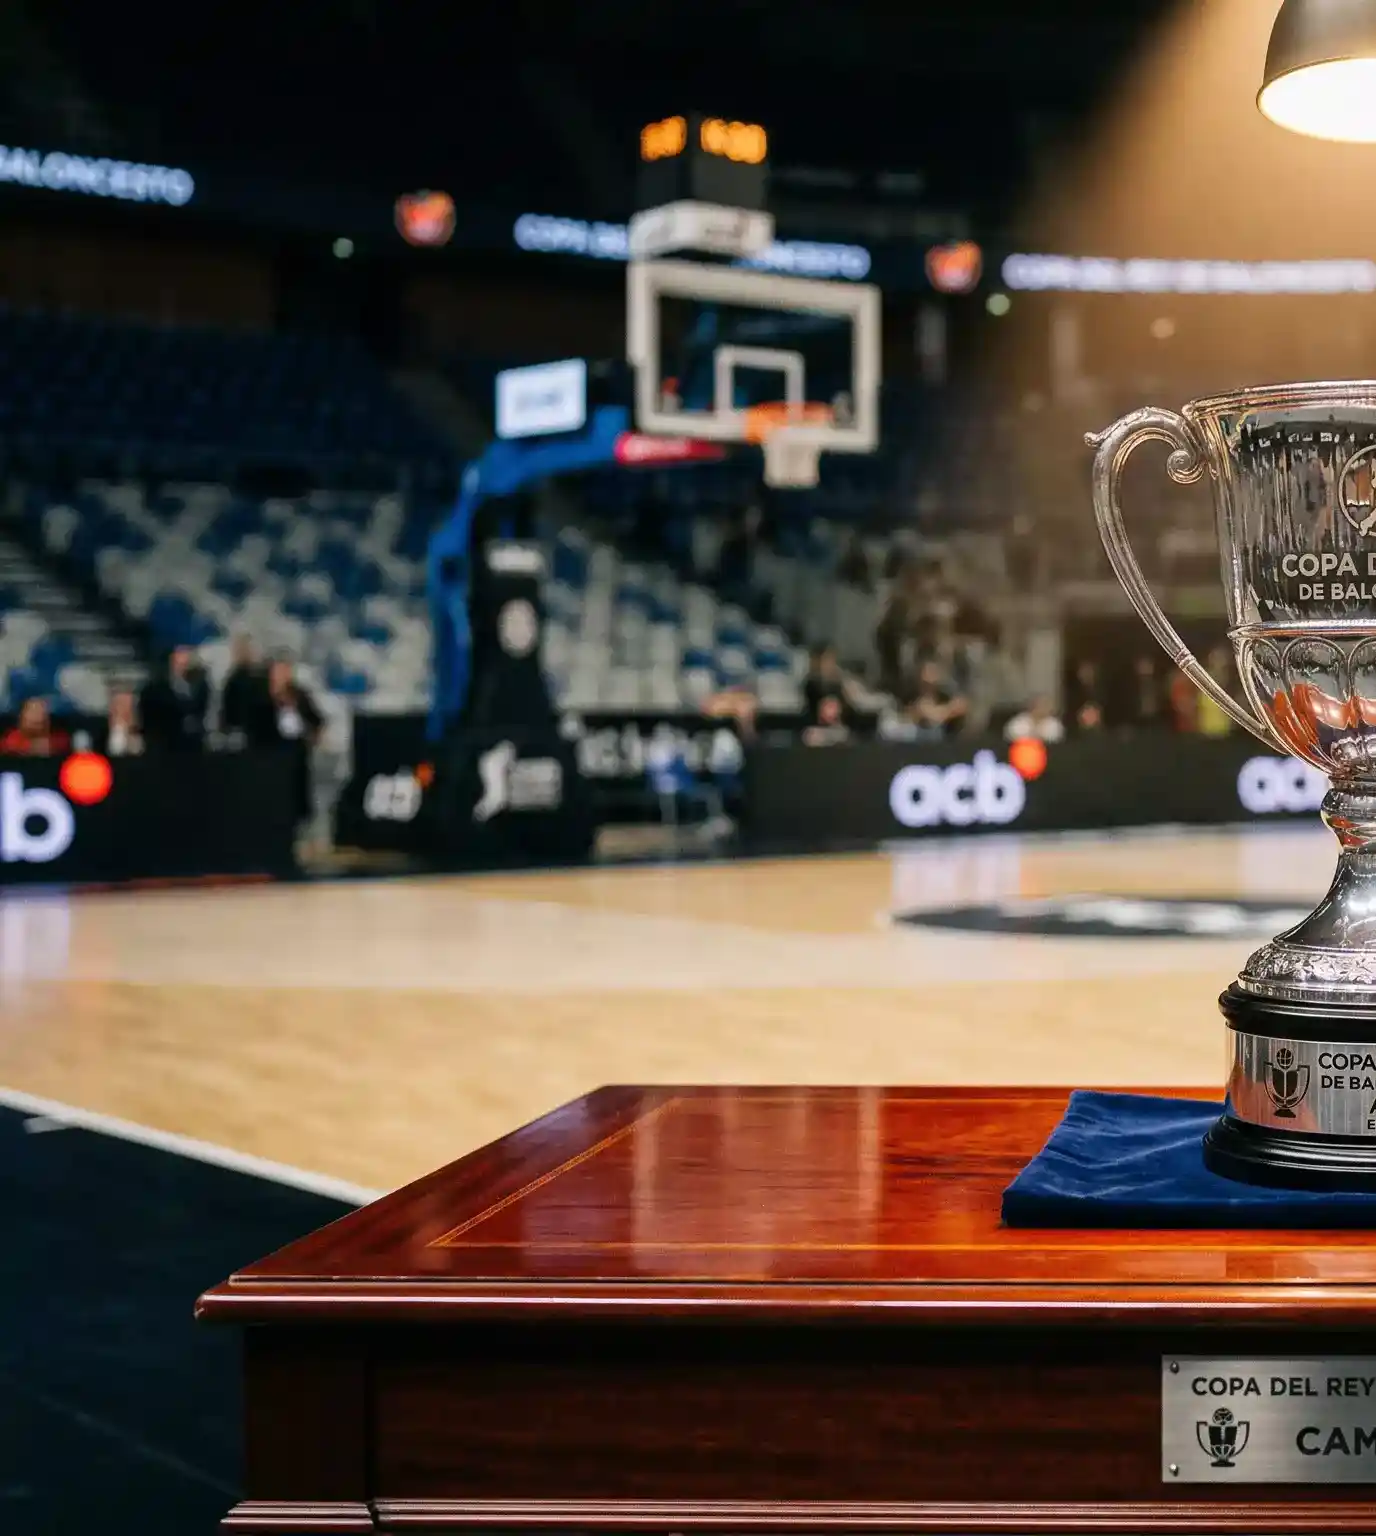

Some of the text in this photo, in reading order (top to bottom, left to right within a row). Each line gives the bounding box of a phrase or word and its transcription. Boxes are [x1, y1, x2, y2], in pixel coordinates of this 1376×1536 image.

[1282, 553, 1358, 577] COPA
[1300, 583, 1324, 600] DE
[888, 748, 1026, 828] acb
[1318, 1052, 1376, 1071] COPA
[1321, 1075, 1345, 1089] DE
[1191, 1377, 1261, 1397] COPA
[1270, 1377, 1318, 1397] DEL
[1326, 1377, 1375, 1397] REY
